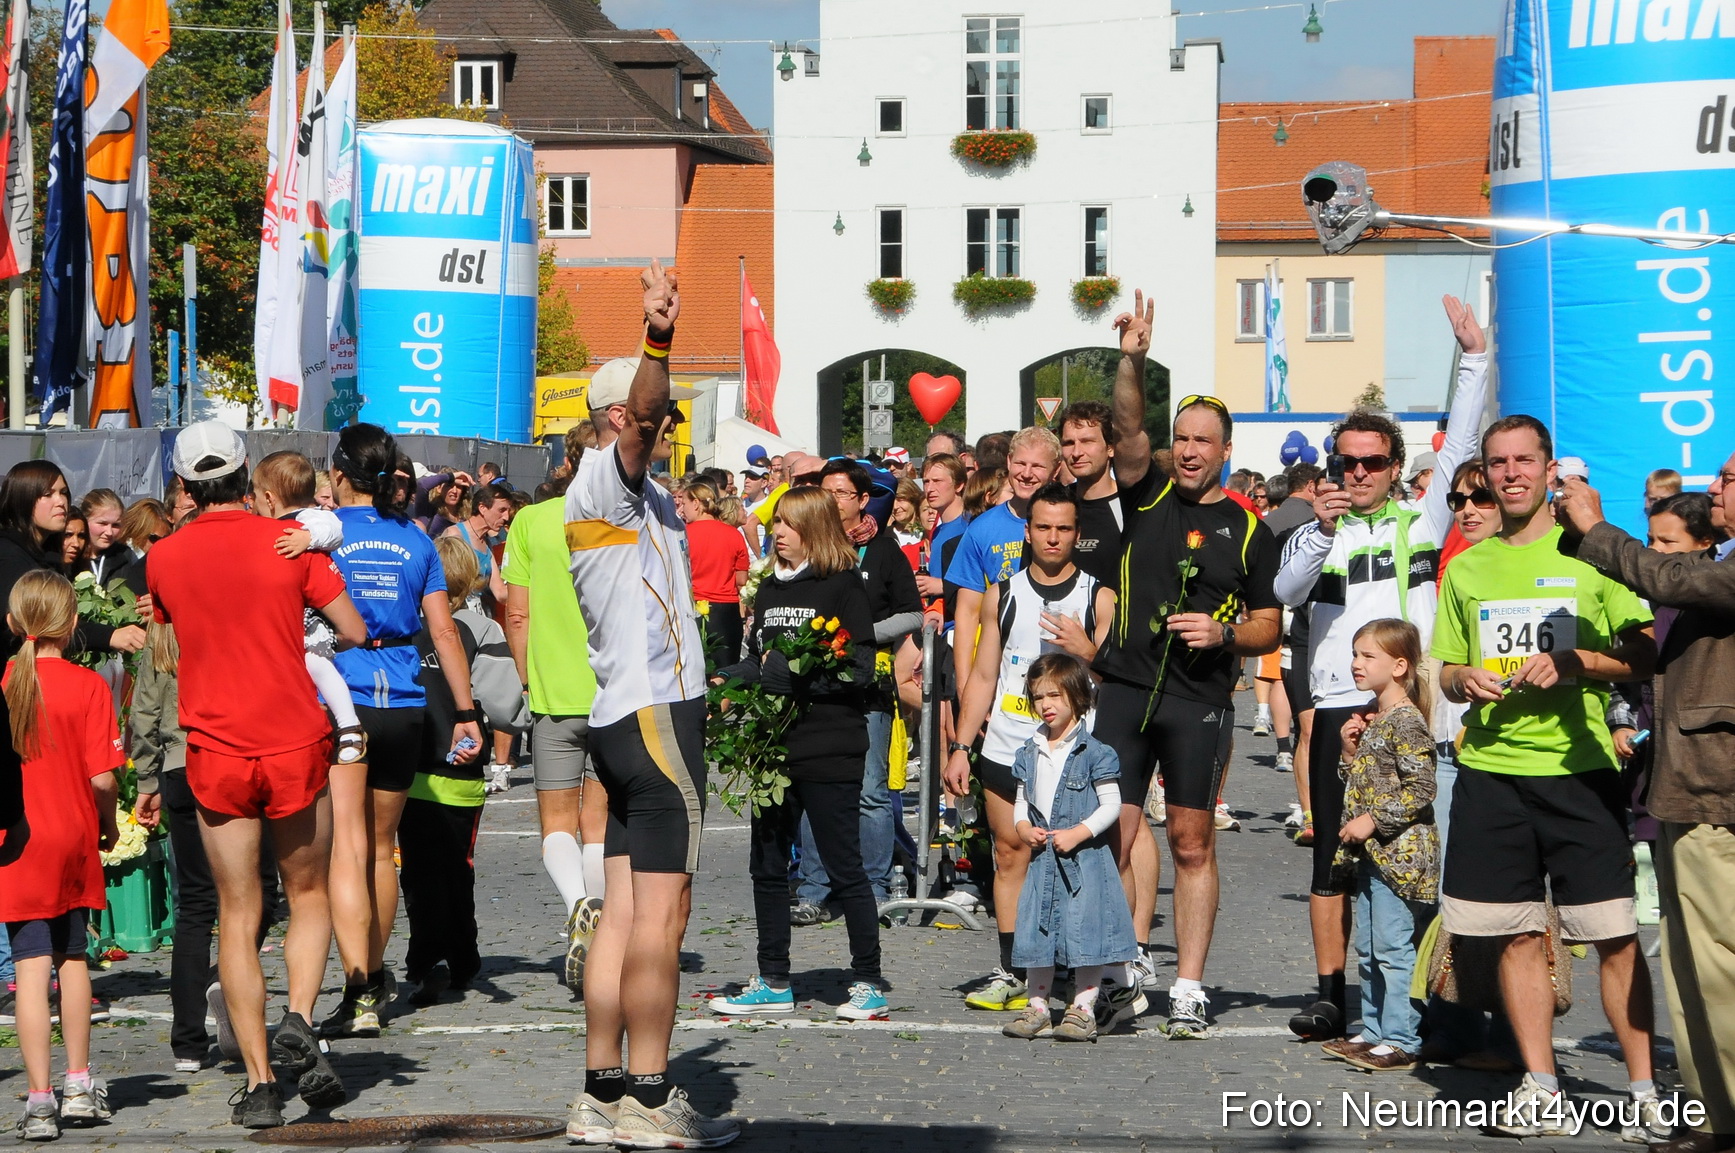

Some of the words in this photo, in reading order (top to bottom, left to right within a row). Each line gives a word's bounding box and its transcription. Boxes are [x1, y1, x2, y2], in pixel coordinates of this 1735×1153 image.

[1696, 95, 1735, 154] d
[1493, 110, 1521, 171] dsl
[371, 156, 495, 216] maxi
[439, 248, 486, 284] dsl
[541, 385, 585, 407] Glossner
[337, 540, 412, 560] funrunners
[991, 544, 1003, 554] 10.
[1004, 540, 1024, 551] NEU
[1377, 556, 1395, 567] TEA
[361, 590, 398, 598] rundschau
[763, 607, 816, 618] NEUMARKTER
[1490, 606, 1531, 616] PFLEIDERER
[1496, 622, 1555, 654] 346
[596, 1068, 622, 1077] TAO
[635, 1074, 663, 1083] TAO
